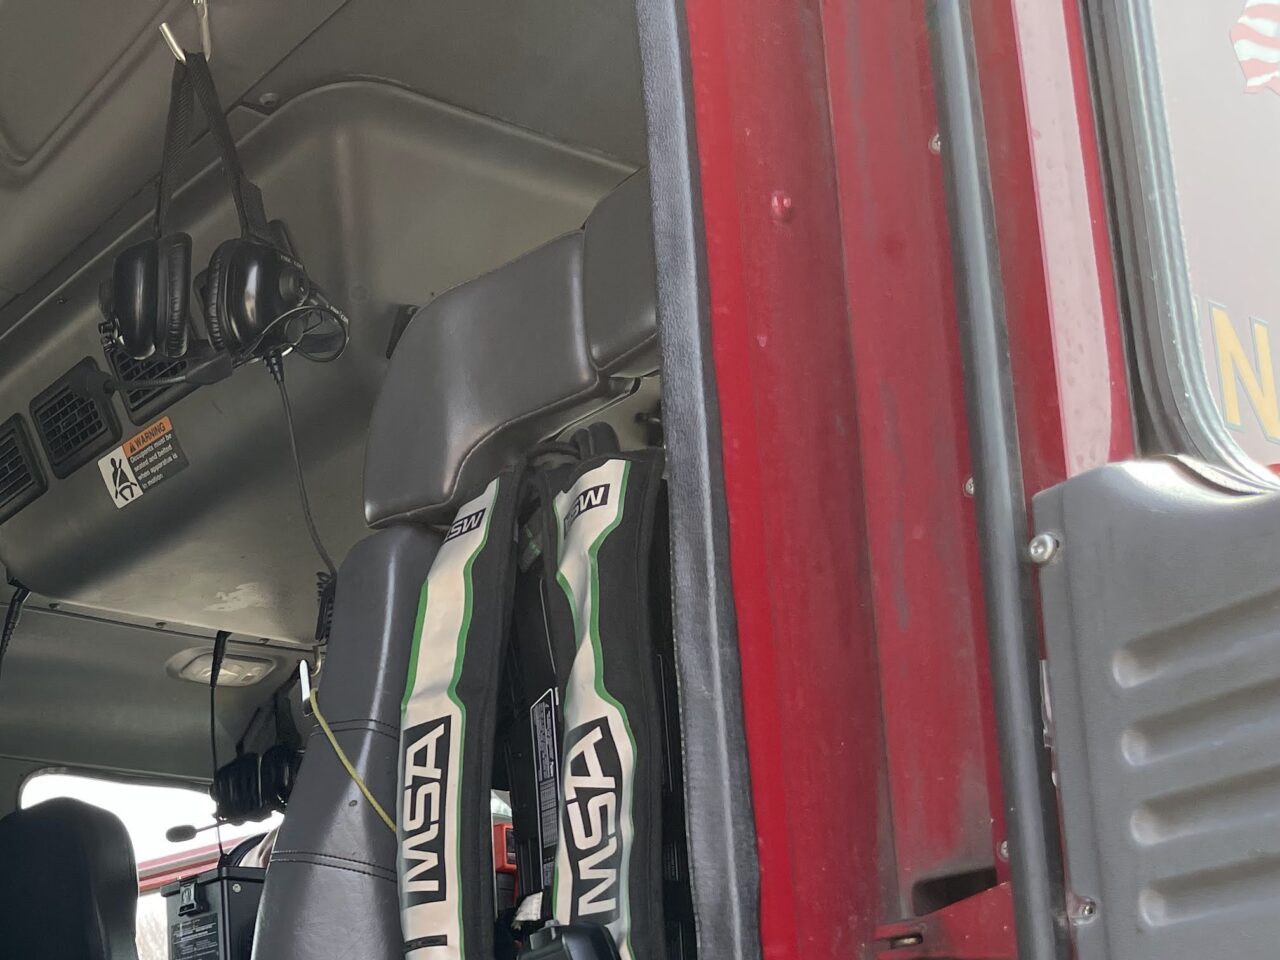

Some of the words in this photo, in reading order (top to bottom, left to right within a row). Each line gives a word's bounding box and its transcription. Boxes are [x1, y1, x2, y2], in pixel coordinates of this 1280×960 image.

[133, 422, 166, 447] WARNING
[133, 458, 149, 473] seated
[148, 452, 158, 463] and
[157, 443, 173, 457] belted
[137, 470, 151, 481] when
[150, 456, 173, 473] apparatus
[402, 723, 445, 893] MSA
[564, 726, 618, 916] MSA
